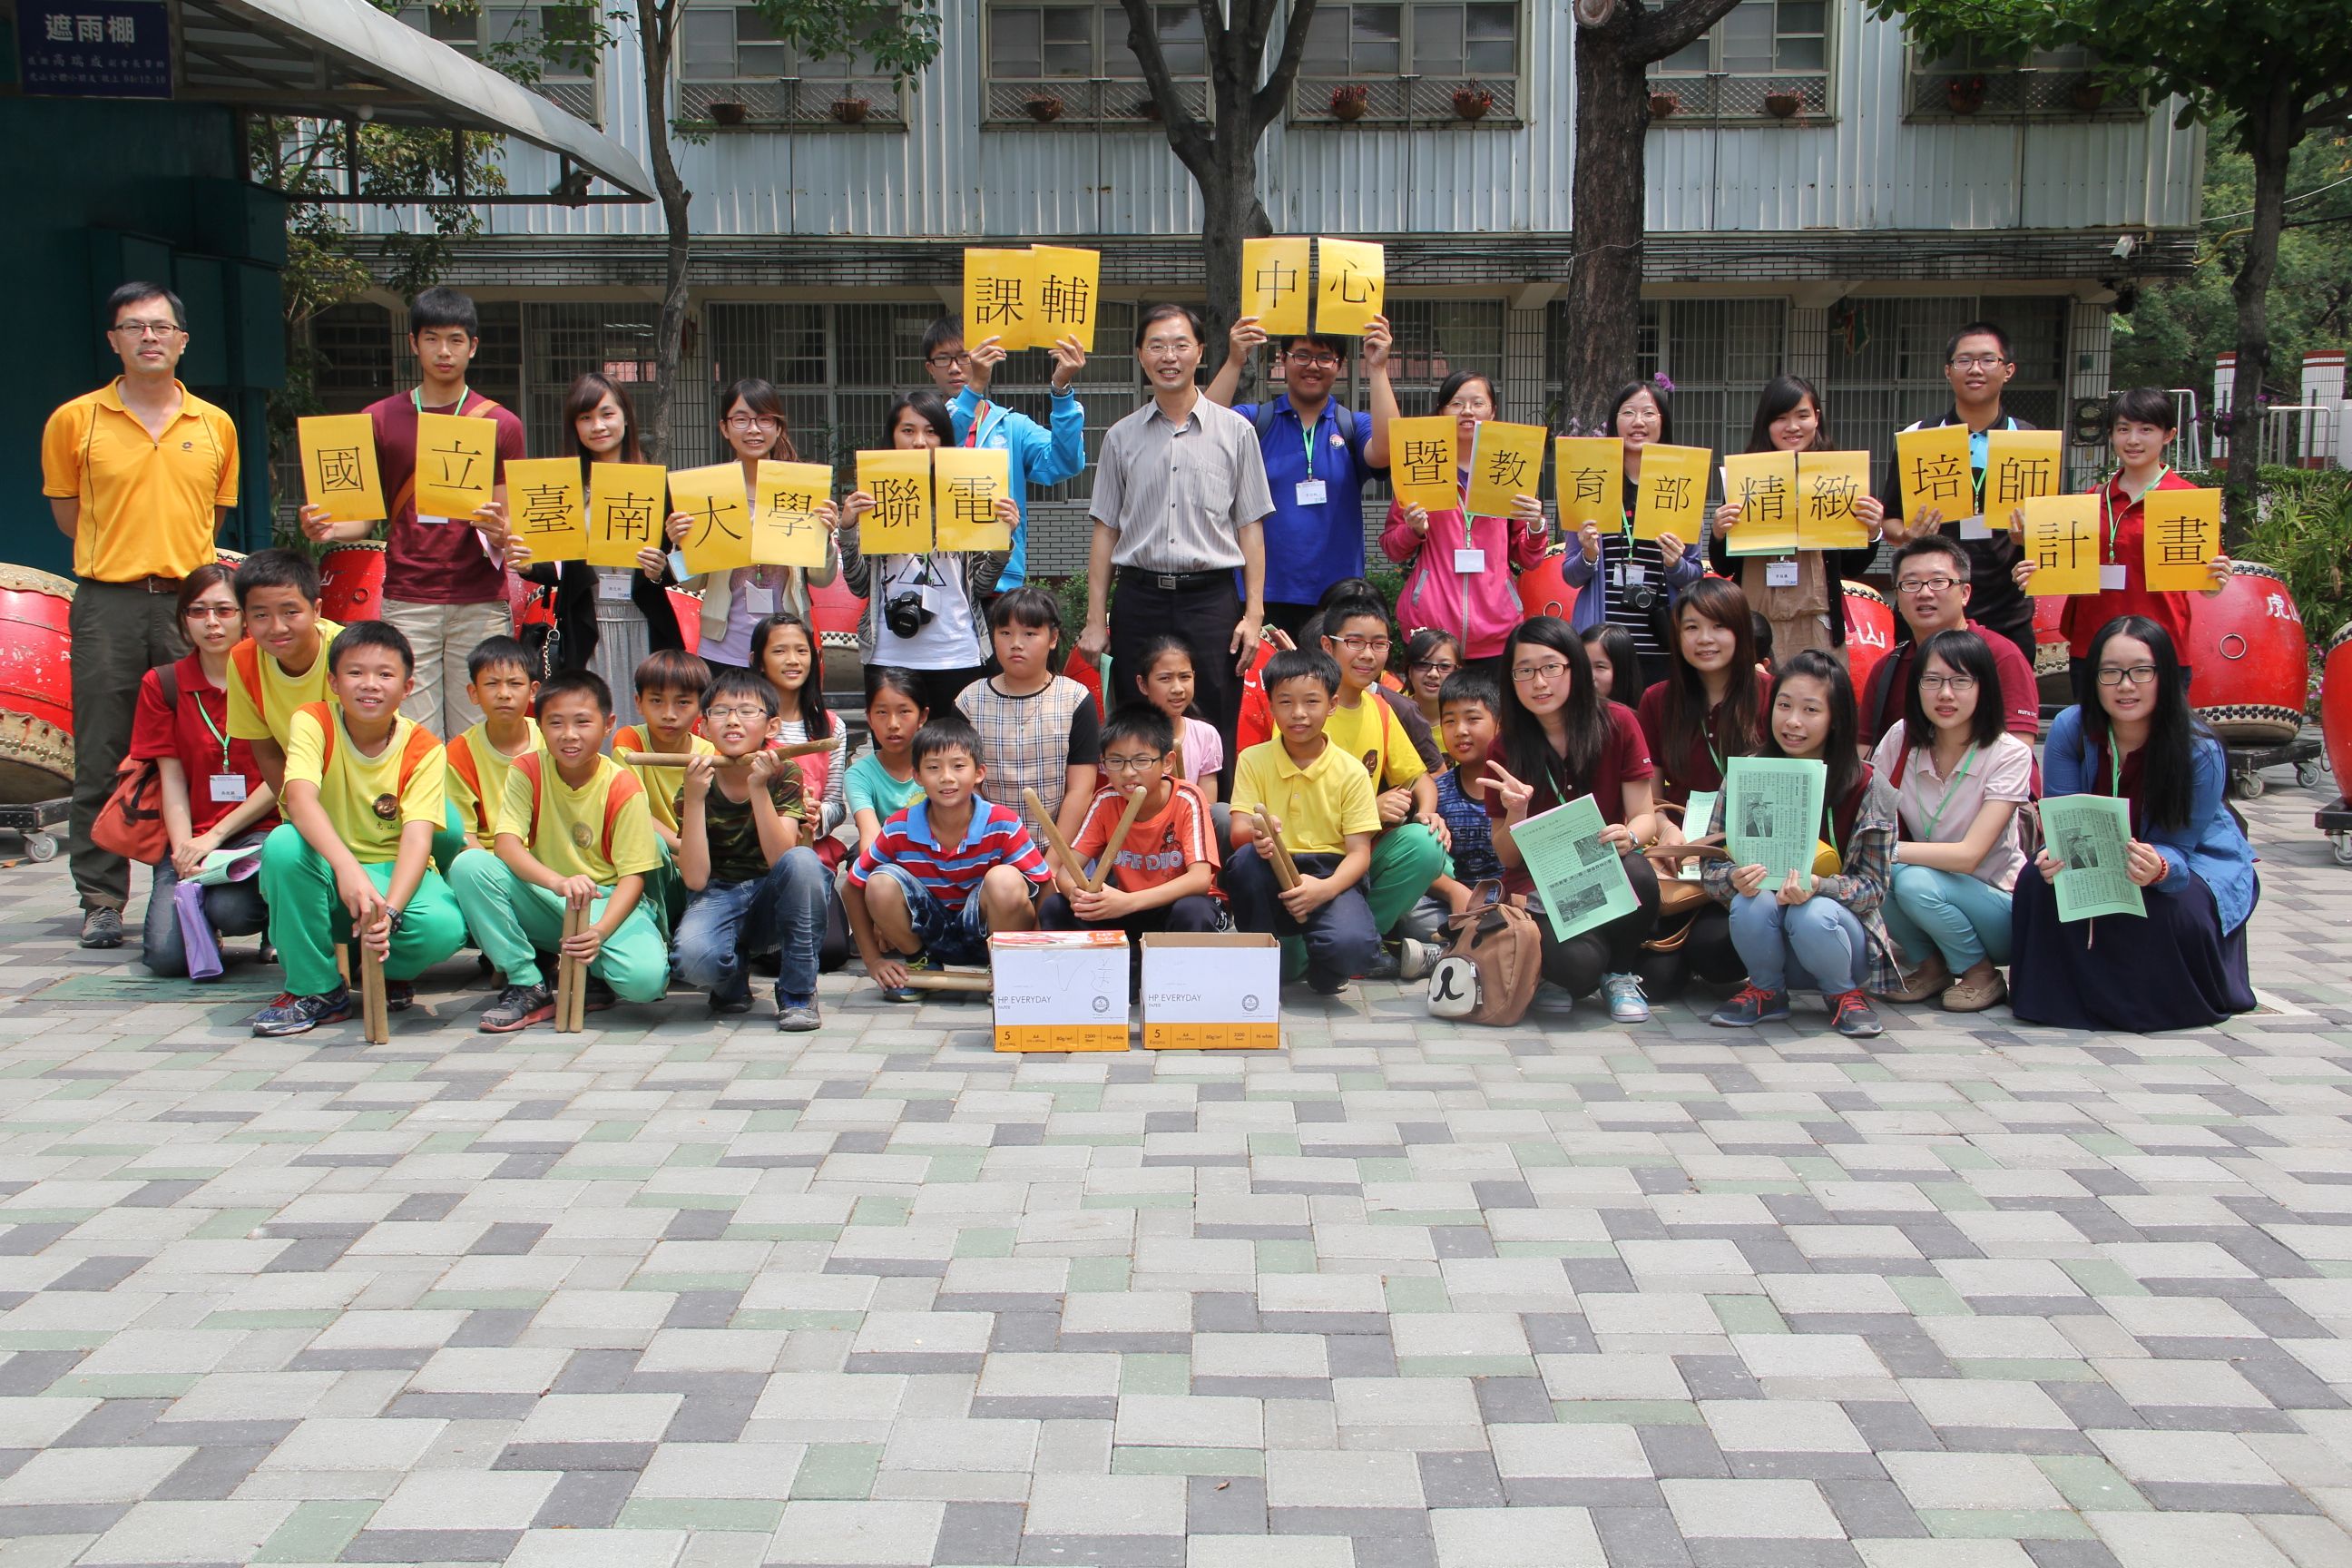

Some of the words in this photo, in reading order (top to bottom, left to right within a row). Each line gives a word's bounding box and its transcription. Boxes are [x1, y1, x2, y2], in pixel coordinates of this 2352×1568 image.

[44, 14, 135, 44] 遮雨棚
[997, 995, 1008, 1004] HP
[1011, 995, 1052, 1004] EVERYDAY
[1148, 994, 1159, 1002] HP
[1161, 994, 1202, 1002] EVERYDAY
[1004, 1031, 1011, 1041] 5
[1153, 1029, 1161, 1038] 5
